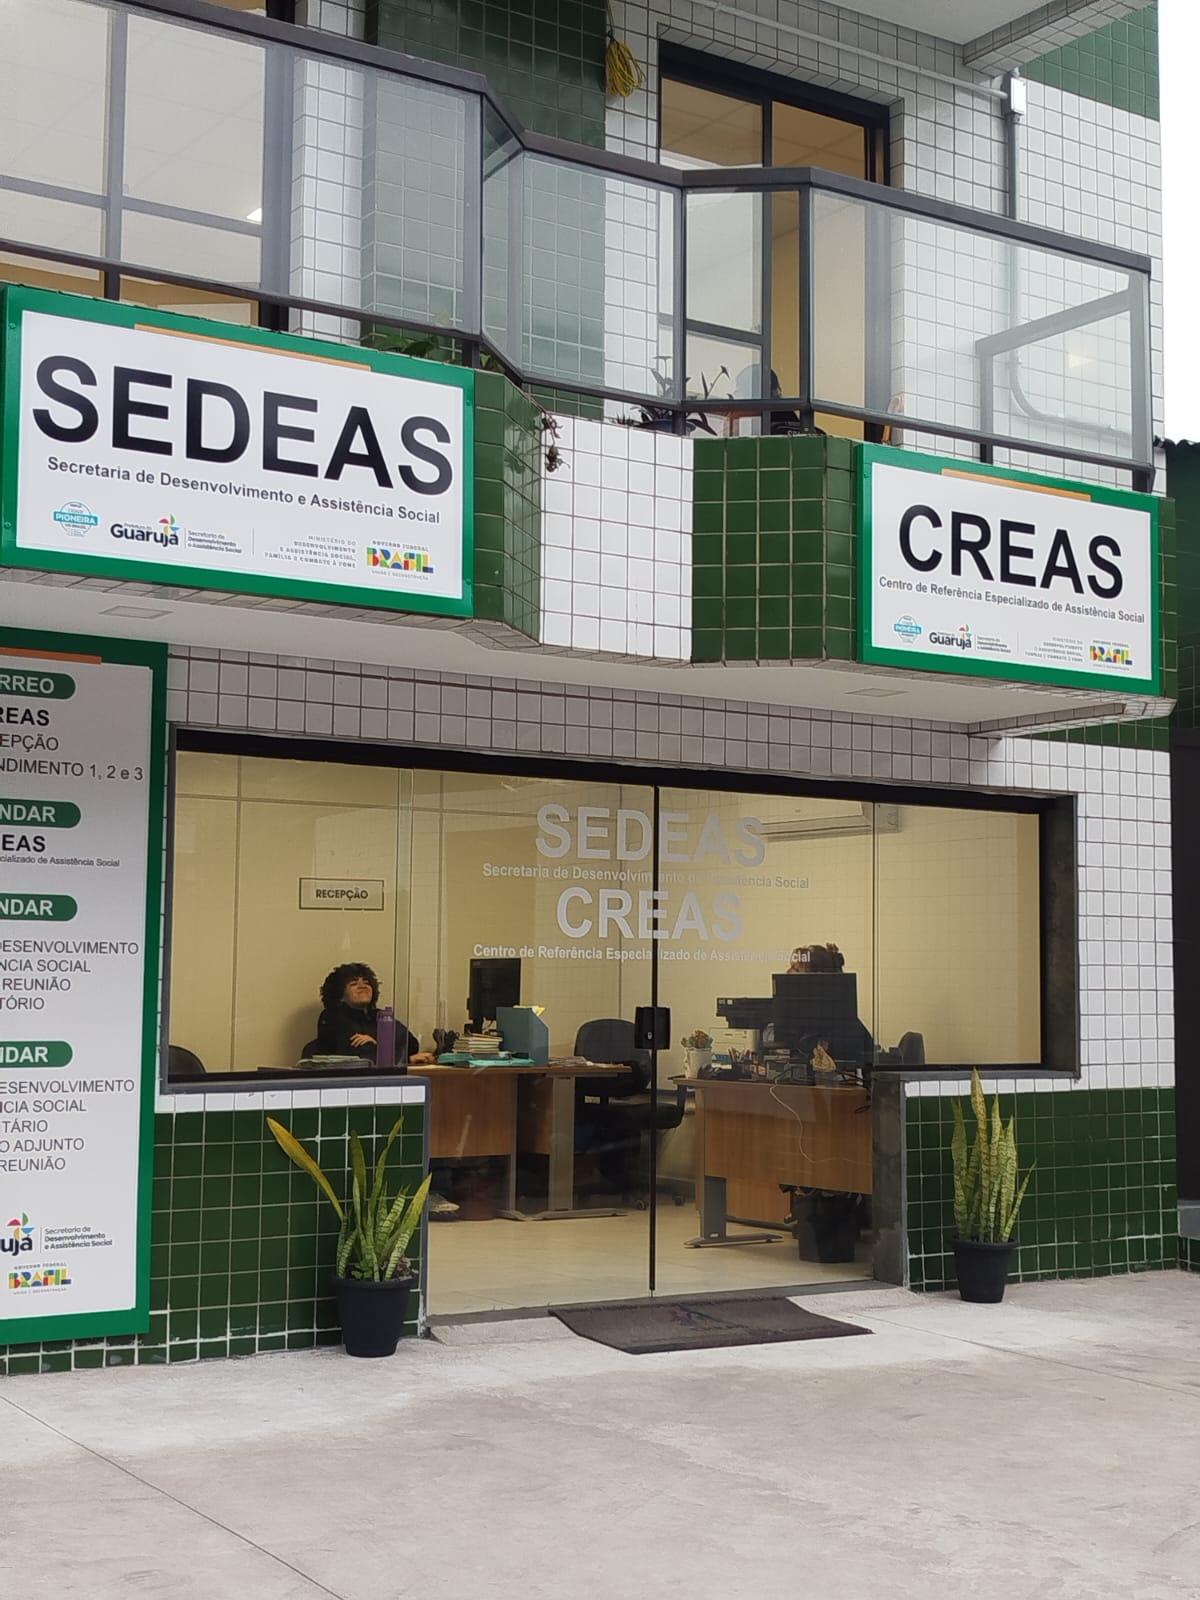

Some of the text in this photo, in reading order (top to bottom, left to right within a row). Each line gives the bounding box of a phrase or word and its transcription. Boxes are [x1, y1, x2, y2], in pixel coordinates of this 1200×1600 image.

[32, 355, 454, 496] SEDEAS
[48, 456, 440, 524] Secretaria de Desenvolvimento e Assistência Social
[55, 513, 97, 525] PIONEIRA
[110, 523, 179, 547] Guarujá
[366, 547, 434, 574] BRASIL
[899, 504, 1123, 599] CREAS
[879, 576, 1145, 623] Centro de Referência Especializado de Assistência Social
[929, 632, 972, 650] Guarujá
[1089, 645, 1133, 665] BRASIL
[90, 764, 102, 780] 1,
[107, 765, 116, 779] 2
[120, 768, 130, 780] e
[134, 767, 143, 780] 3
[0, 803, 56, 823] NDAR
[2, 834, 46, 853] EAS
[535, 803, 767, 869] SEDEAS
[37, 856, 48, 865] de
[50, 856, 94, 867] Assistência
[96, 858, 120, 867] Social
[482, 863, 550, 879] Secretaria
[553, 865, 569, 879] de
[775, 876, 810, 890] Social
[316, 887, 369, 901] RECEPÇÃO
[0, 898, 54, 916] NDAR
[556, 886, 745, 943] CREAS
[0, 940, 139, 954] ESENVOLVIMENTO
[473, 943, 516, 958] Centro
[519, 945, 535, 959] de
[538, 945, 603, 960] Referência
[606, 947, 690, 963] Especializado
[693, 949, 707, 961] de
[36, 959, 91, 973] SOCIAL
[2, 976, 71, 991] REUNIÃO
[0, 1099, 87, 1113] CIA SOCIAL
[2, 1118, 48, 1133] TÁRIO
[13, 1138, 85, 1152] ADJUNTO
[44, 1226, 81, 1235] Secretaria
[44, 1232, 106, 1242] Desenvolvimento
[50, 1239, 91, 1250] Assistência
[91, 1239, 113, 1248] Social
[8, 1268, 72, 1289] BRASIL
